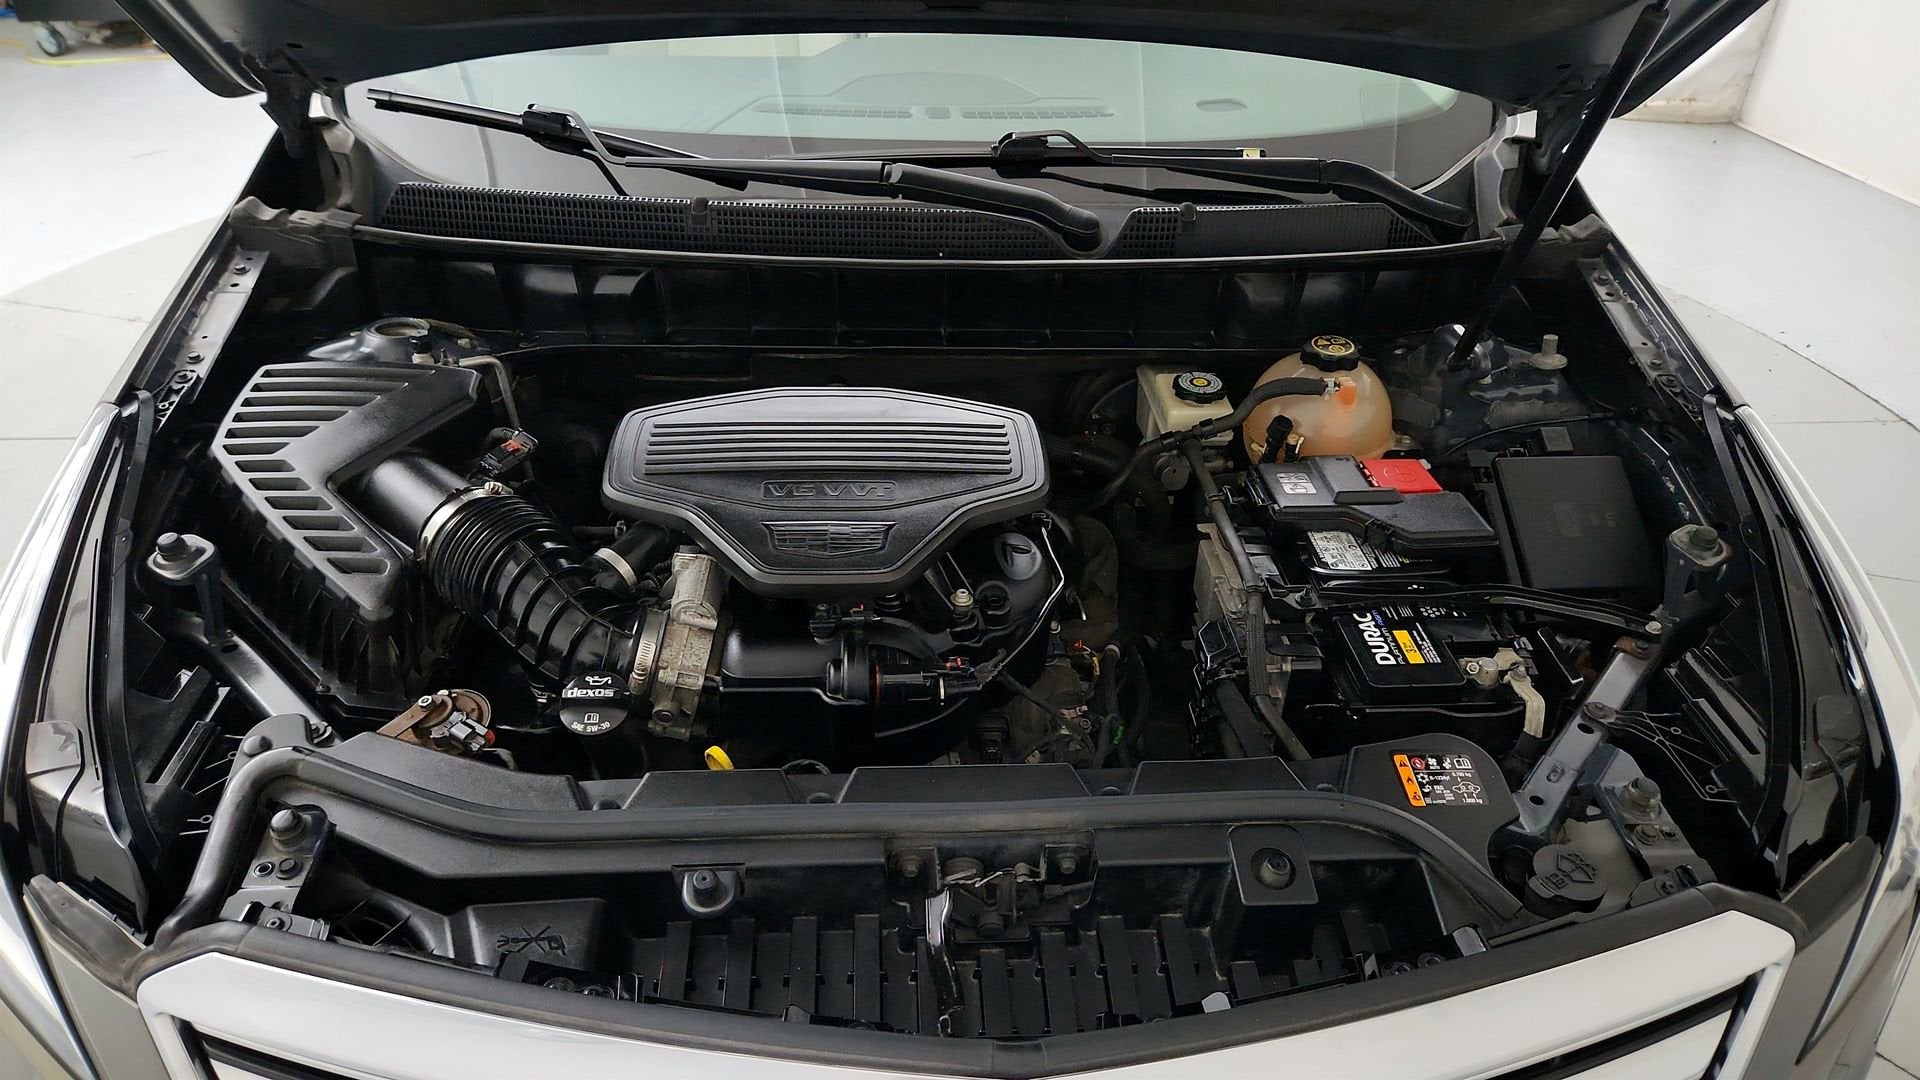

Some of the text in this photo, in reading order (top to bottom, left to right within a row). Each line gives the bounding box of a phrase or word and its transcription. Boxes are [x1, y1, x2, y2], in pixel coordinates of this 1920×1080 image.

[768, 484, 892, 497] V6 VVT
[567, 687, 614, 698] dexos
[571, 721, 611, 732] SAE 5W-30
